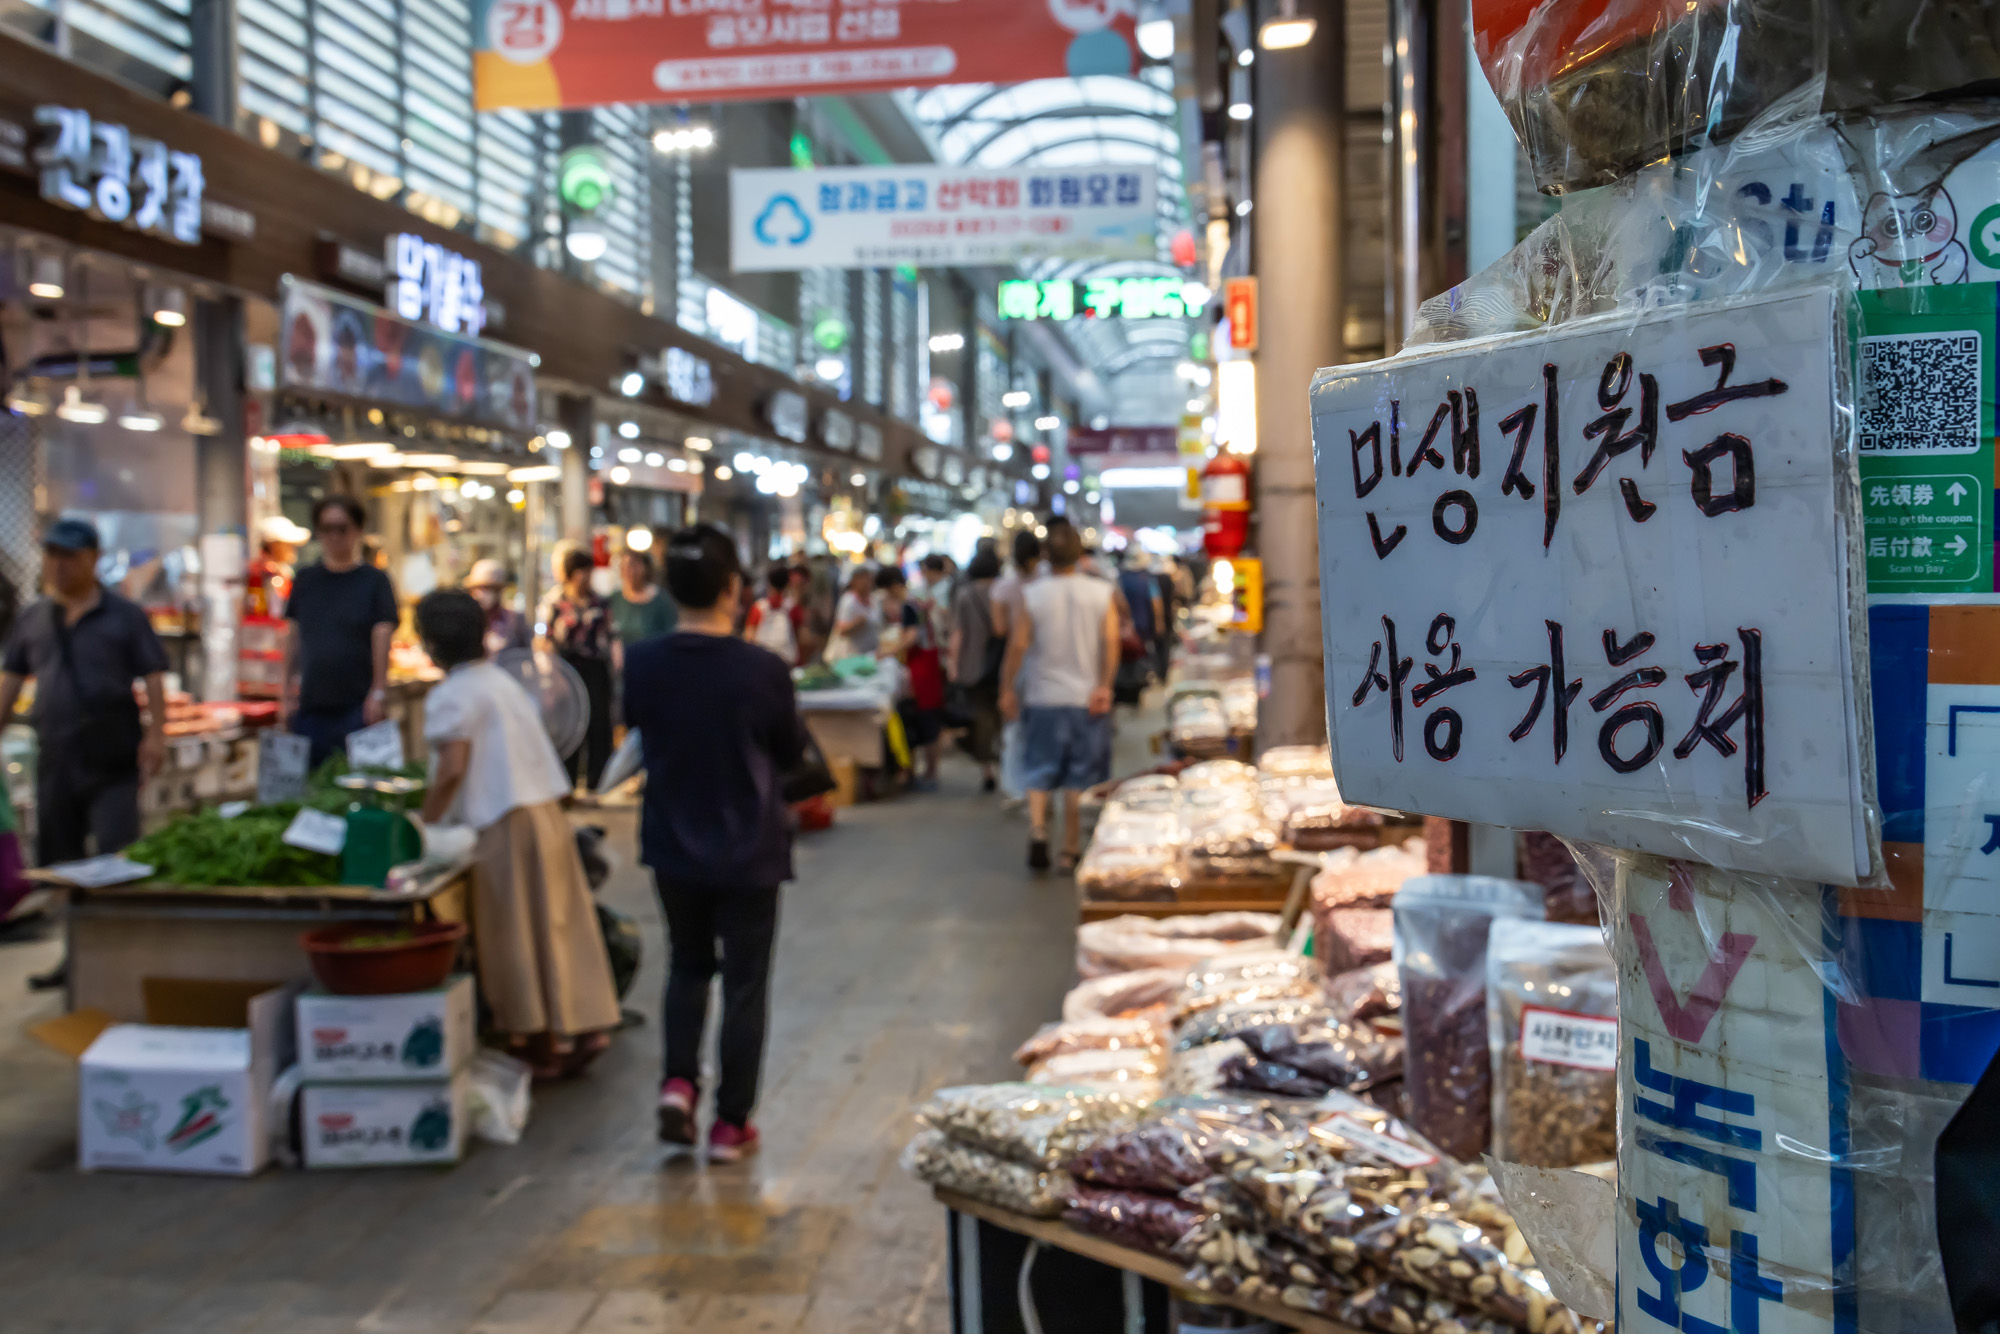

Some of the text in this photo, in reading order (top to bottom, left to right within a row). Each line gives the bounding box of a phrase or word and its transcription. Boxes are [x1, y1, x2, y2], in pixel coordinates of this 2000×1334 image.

[1348, 342, 1789, 560] 민생지원금
[1869, 484, 1934, 506] 先领券
[1888, 516, 1898, 524] to
[1917, 514, 1933, 523] the
[1935, 515, 1973, 525] coupon
[1868, 536, 1932, 557] 后付款
[1889, 564, 1944, 575] Scan to pay
[1352, 612, 1476, 763] 사용
